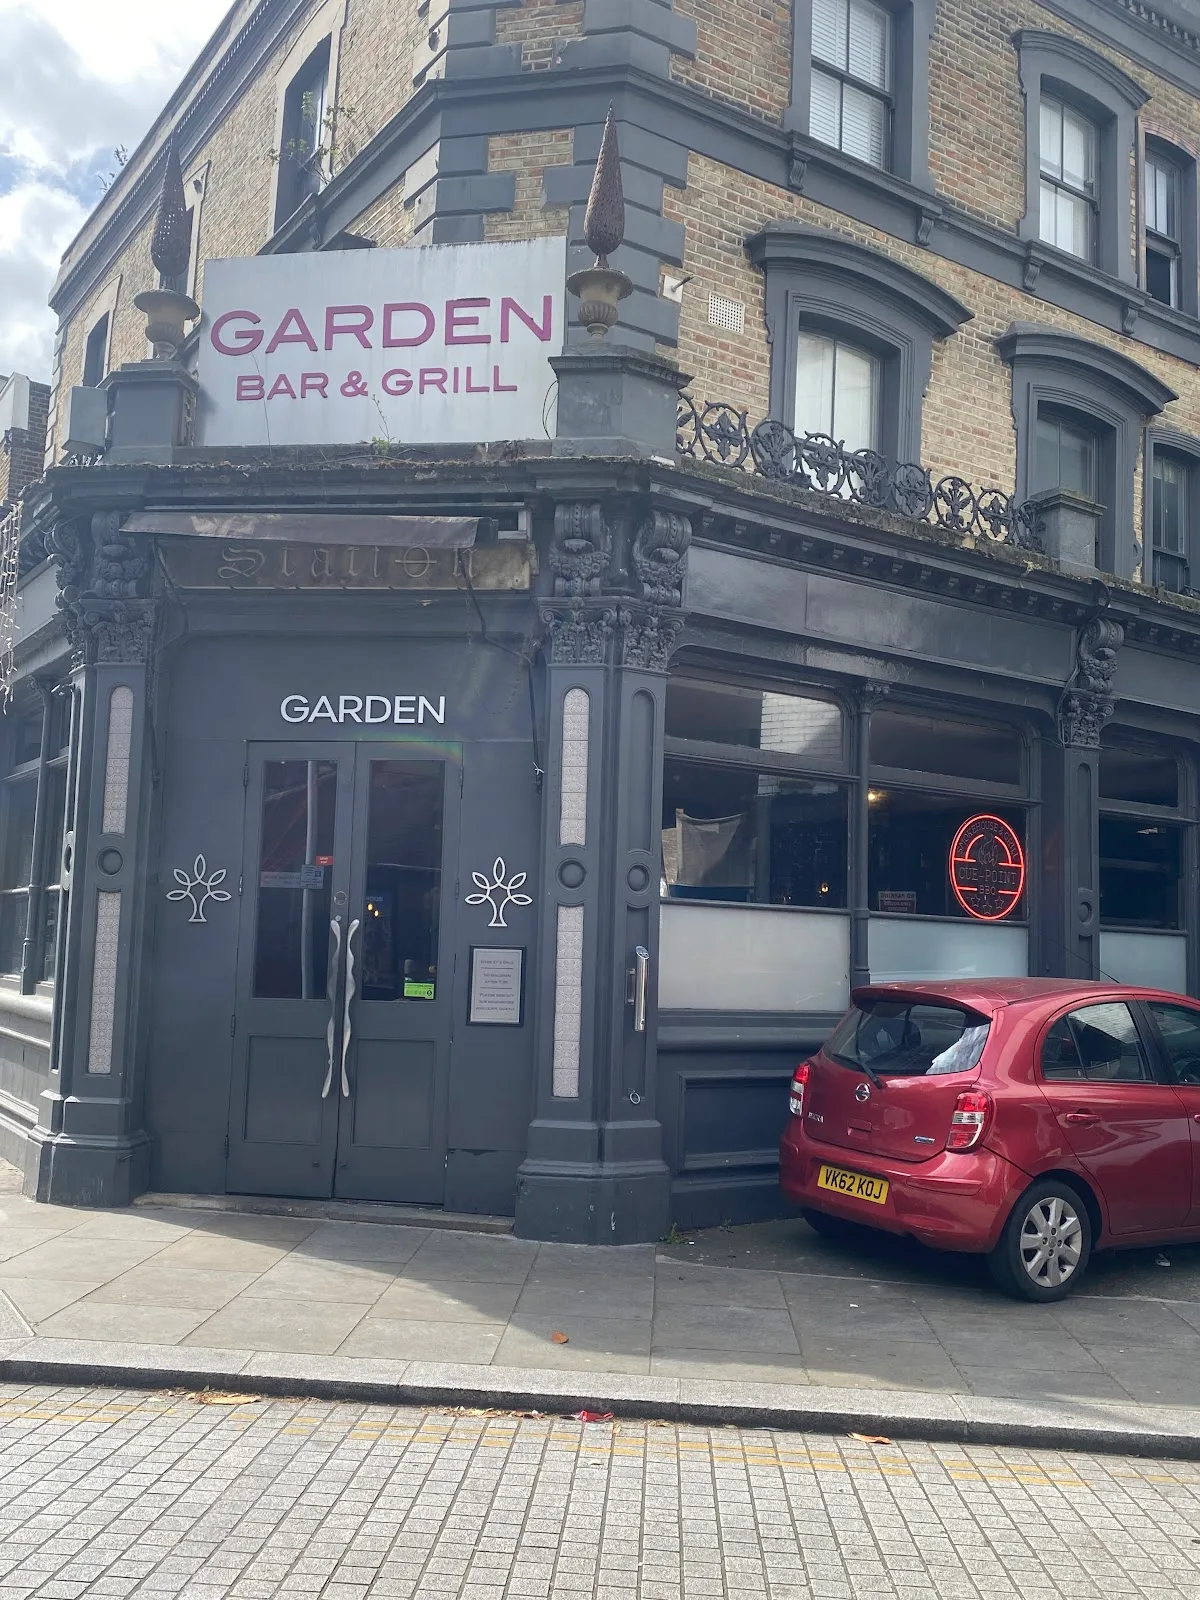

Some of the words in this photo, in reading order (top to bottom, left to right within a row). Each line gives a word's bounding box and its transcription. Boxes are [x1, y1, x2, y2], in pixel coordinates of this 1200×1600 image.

[210, 295, 552, 356] GARDEN
[236, 372, 329, 401] BAR
[340, 370, 369, 397] &
[381, 365, 518, 396] GRILL
[280, 694, 446, 724] GARDEN
[957, 820, 999, 854] SMOKEHOUSE
[999, 827, 1004, 835] &
[1004, 832, 1019, 859] GRILL
[959, 867, 1017, 885] CUE-POINT
[979, 885, 996, 895] BBQ
[825, 1169, 856, 1192] VK62
[857, 1180, 884, 1200] KOJ
